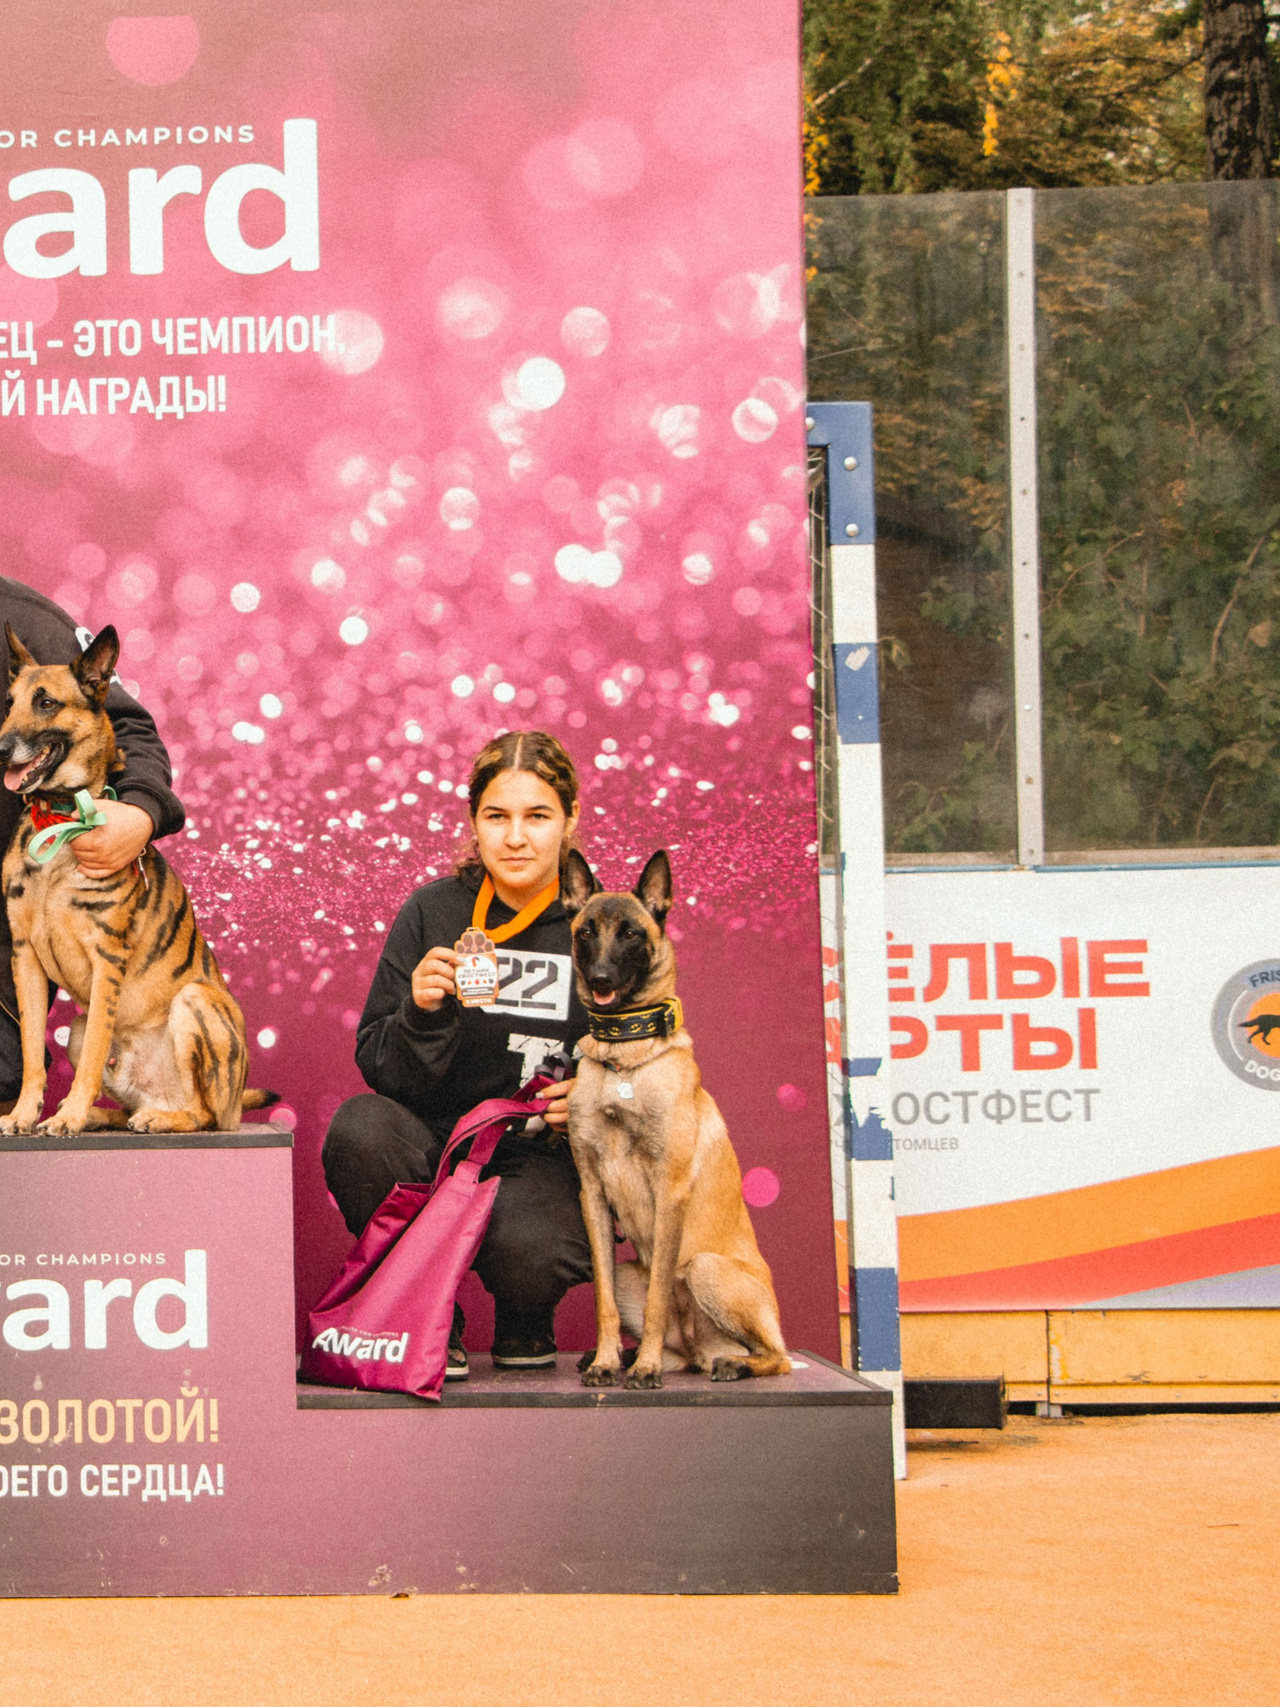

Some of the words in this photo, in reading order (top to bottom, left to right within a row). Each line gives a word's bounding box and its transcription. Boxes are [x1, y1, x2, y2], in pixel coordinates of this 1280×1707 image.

[54, 124, 256, 148] CHAMPIONS
[73, 318, 142, 358] ЭТО
[151, 314, 347, 356] ЧЕМПИОН,
[36, 375, 227, 419] НАГРАДЫ!
[496, 956, 558, 1010] 22
[1243, 1060, 1280, 1081] DOG
[832, 1088, 1100, 1127] ОСТФЕСТ
[36, 1252, 168, 1266] CHAMPIONS
[312, 1327, 409, 1363] Award
[80, 1463, 225, 1502] СЕРДЦА!
